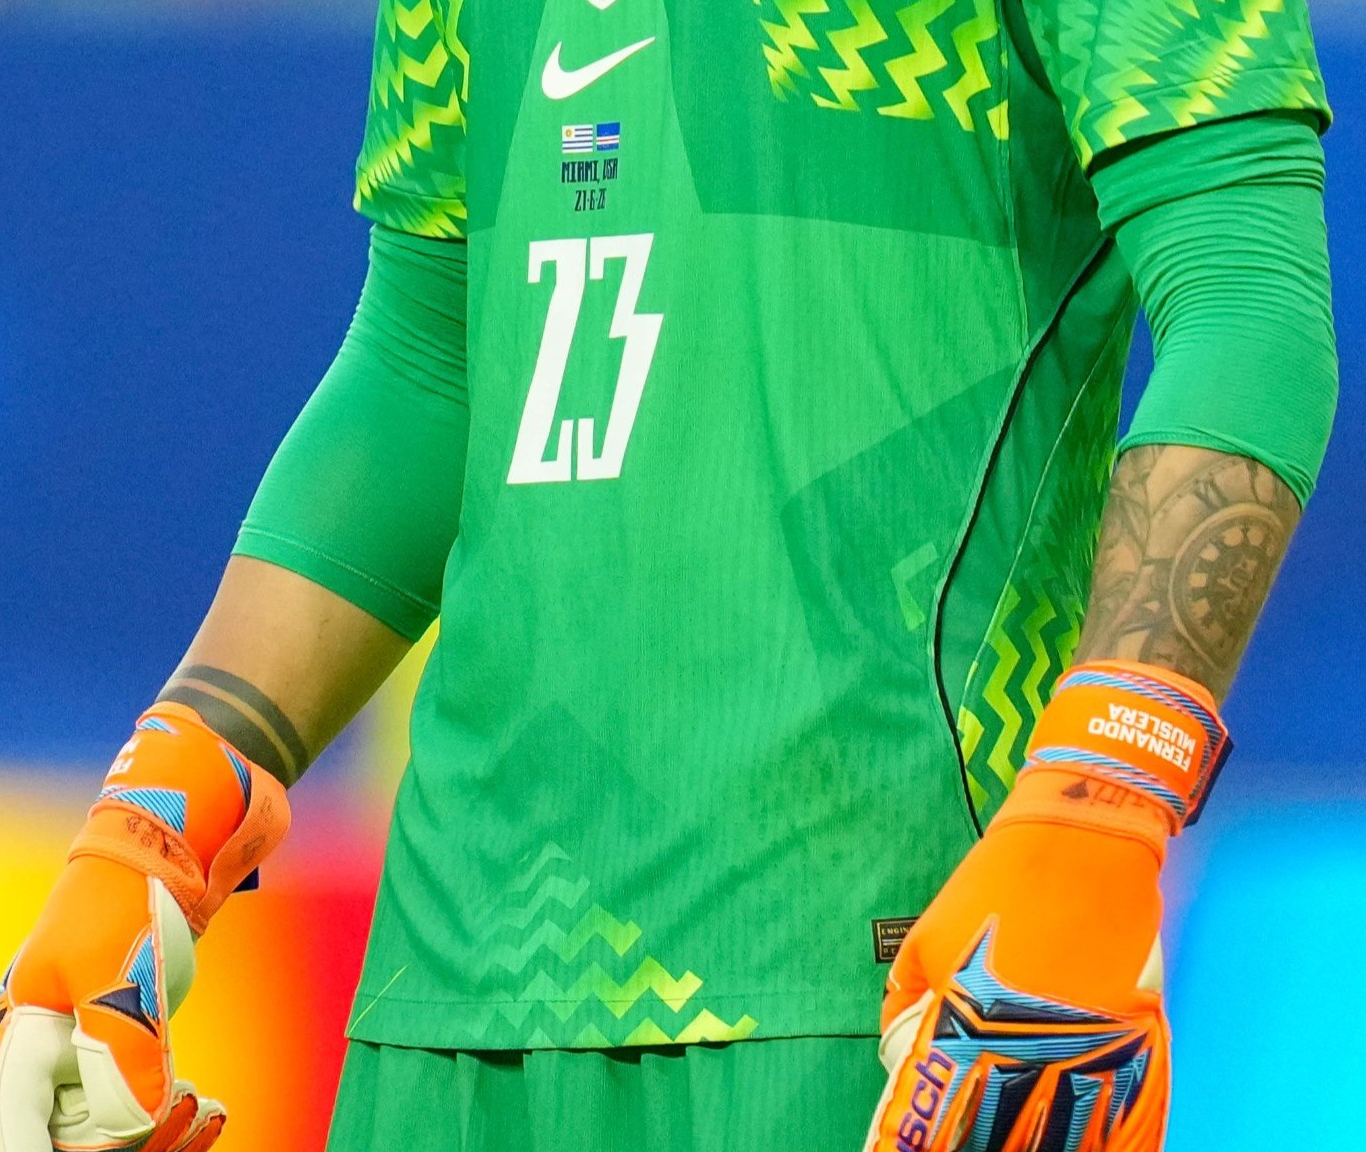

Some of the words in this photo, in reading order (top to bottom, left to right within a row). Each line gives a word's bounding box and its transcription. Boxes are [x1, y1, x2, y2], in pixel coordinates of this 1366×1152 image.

[603, 158, 618, 180] USA
[506, 233, 664, 484] 23
[1088, 717, 1191, 772] FERNANDO
[1108, 704, 1195, 755] MUSLERA
